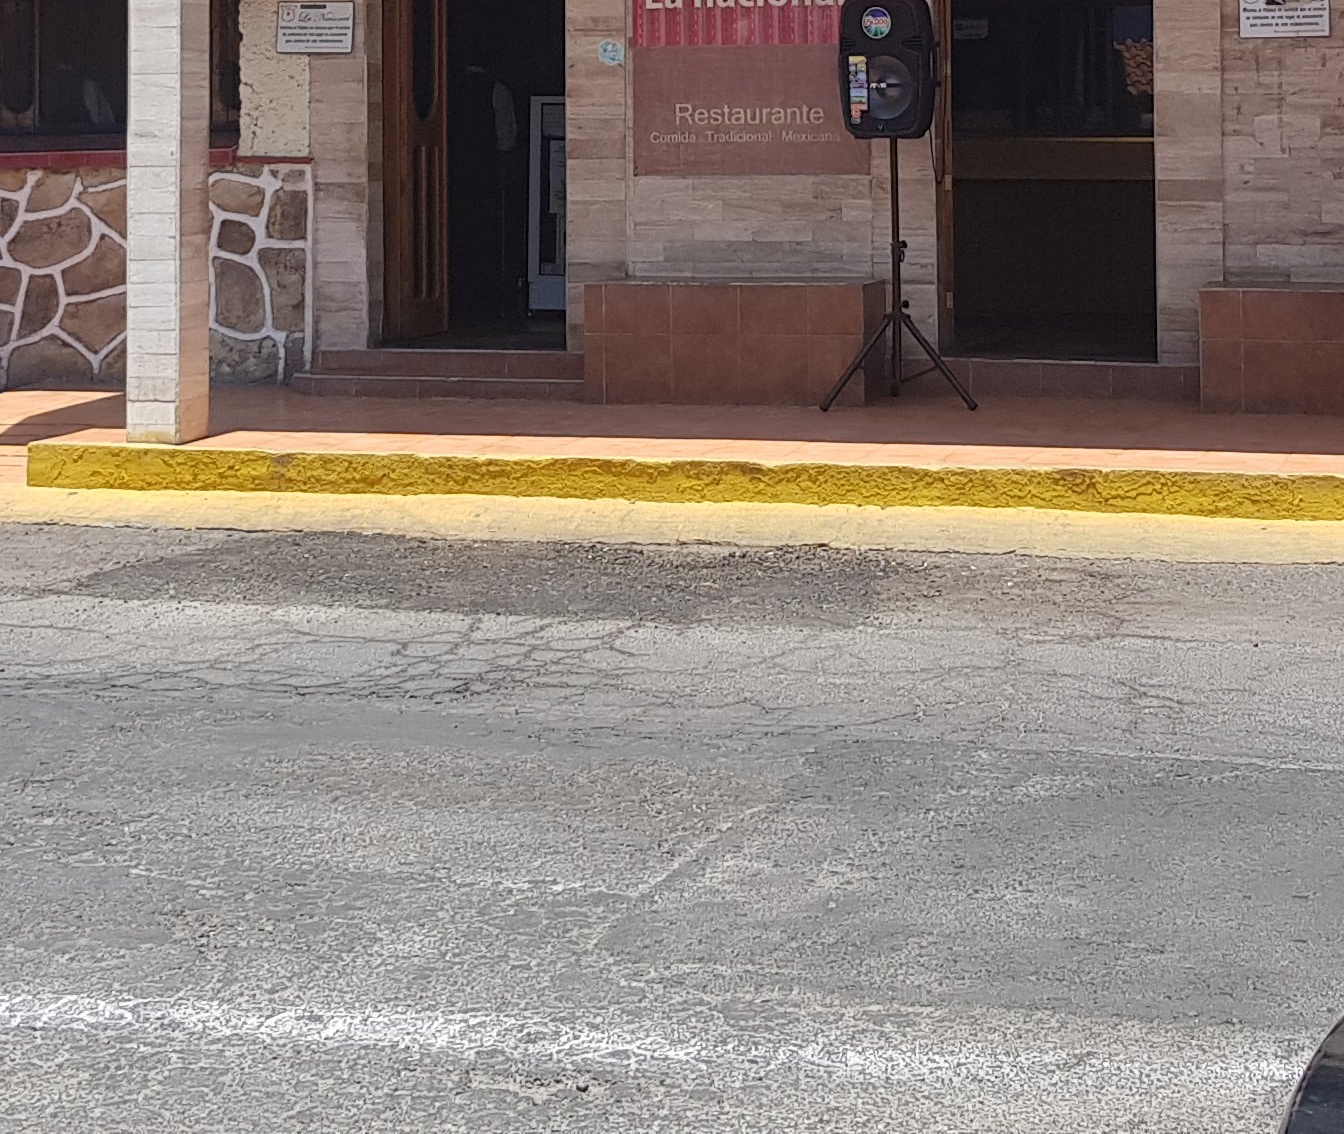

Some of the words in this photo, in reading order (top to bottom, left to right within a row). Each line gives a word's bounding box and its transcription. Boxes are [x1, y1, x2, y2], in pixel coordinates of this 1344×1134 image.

[674, 103, 825, 126] Restaurante
[650, 131, 696, 144] Comida
[706, 130, 772, 143] Tradicional
